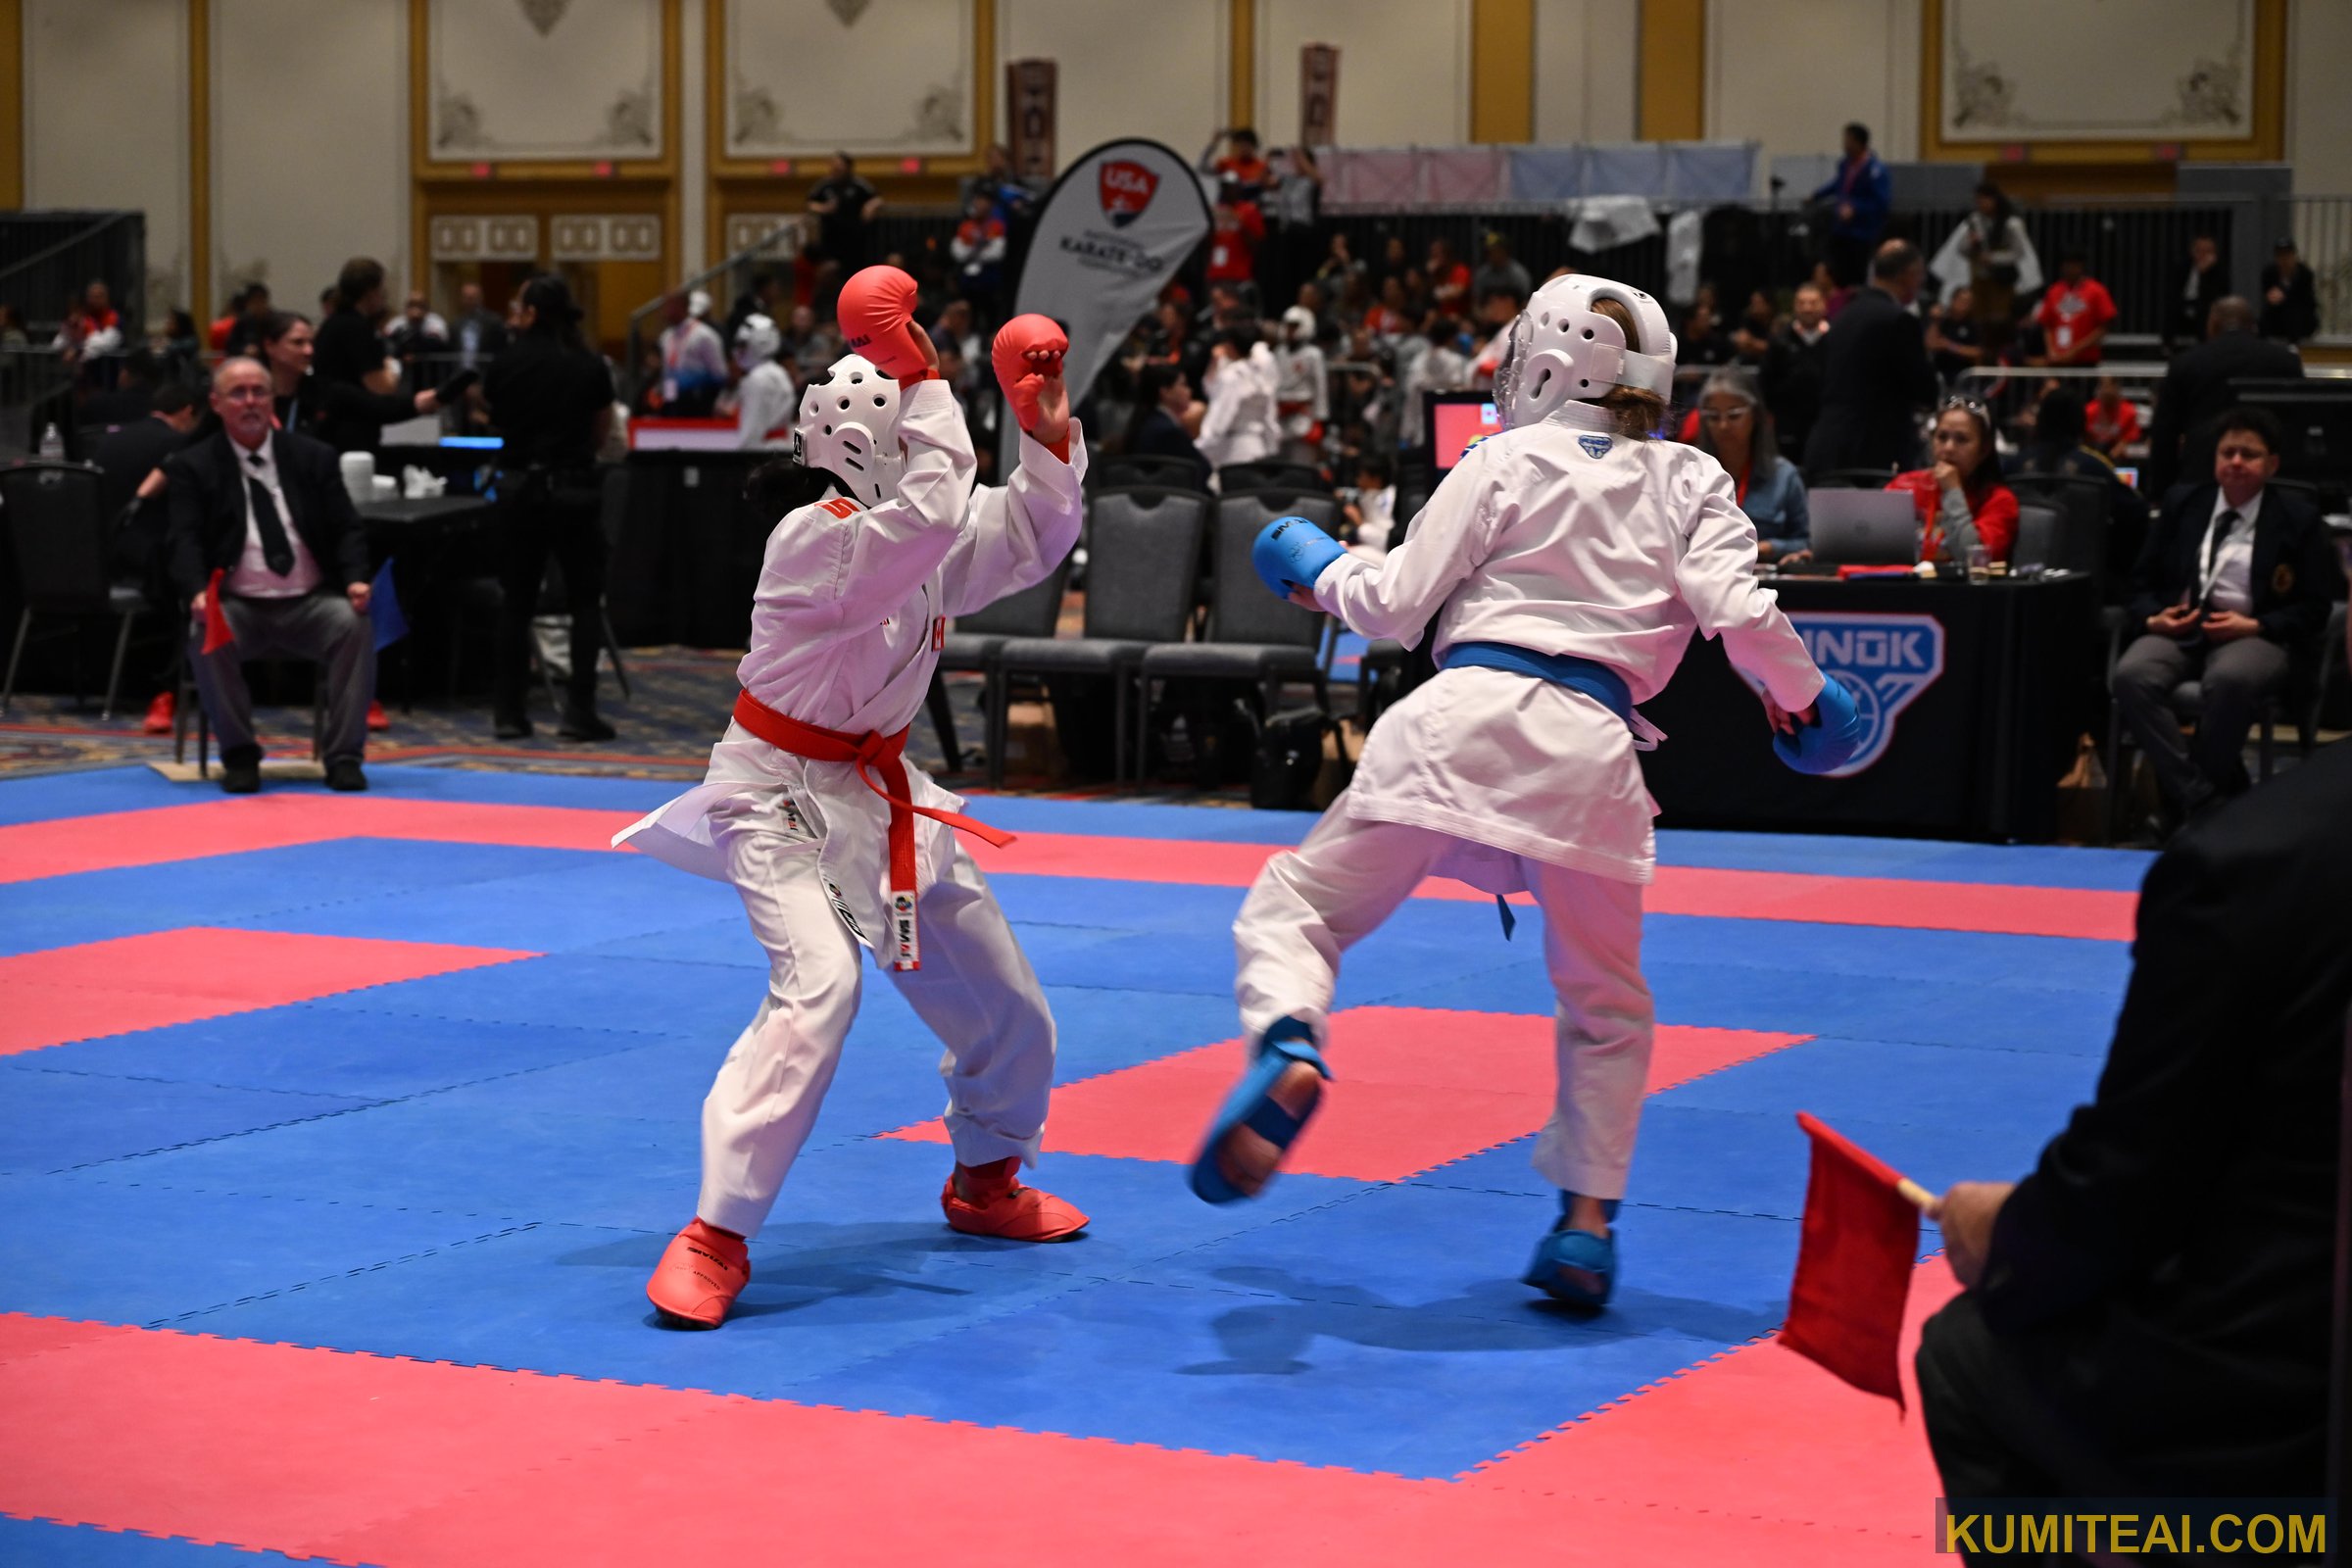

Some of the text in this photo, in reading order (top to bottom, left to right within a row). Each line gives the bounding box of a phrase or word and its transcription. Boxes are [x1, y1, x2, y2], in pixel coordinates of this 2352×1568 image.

[1104, 167, 1150, 195] USA
[1802, 629, 1924, 667] NOK
[693, 1270, 720, 1291] APPROVED
